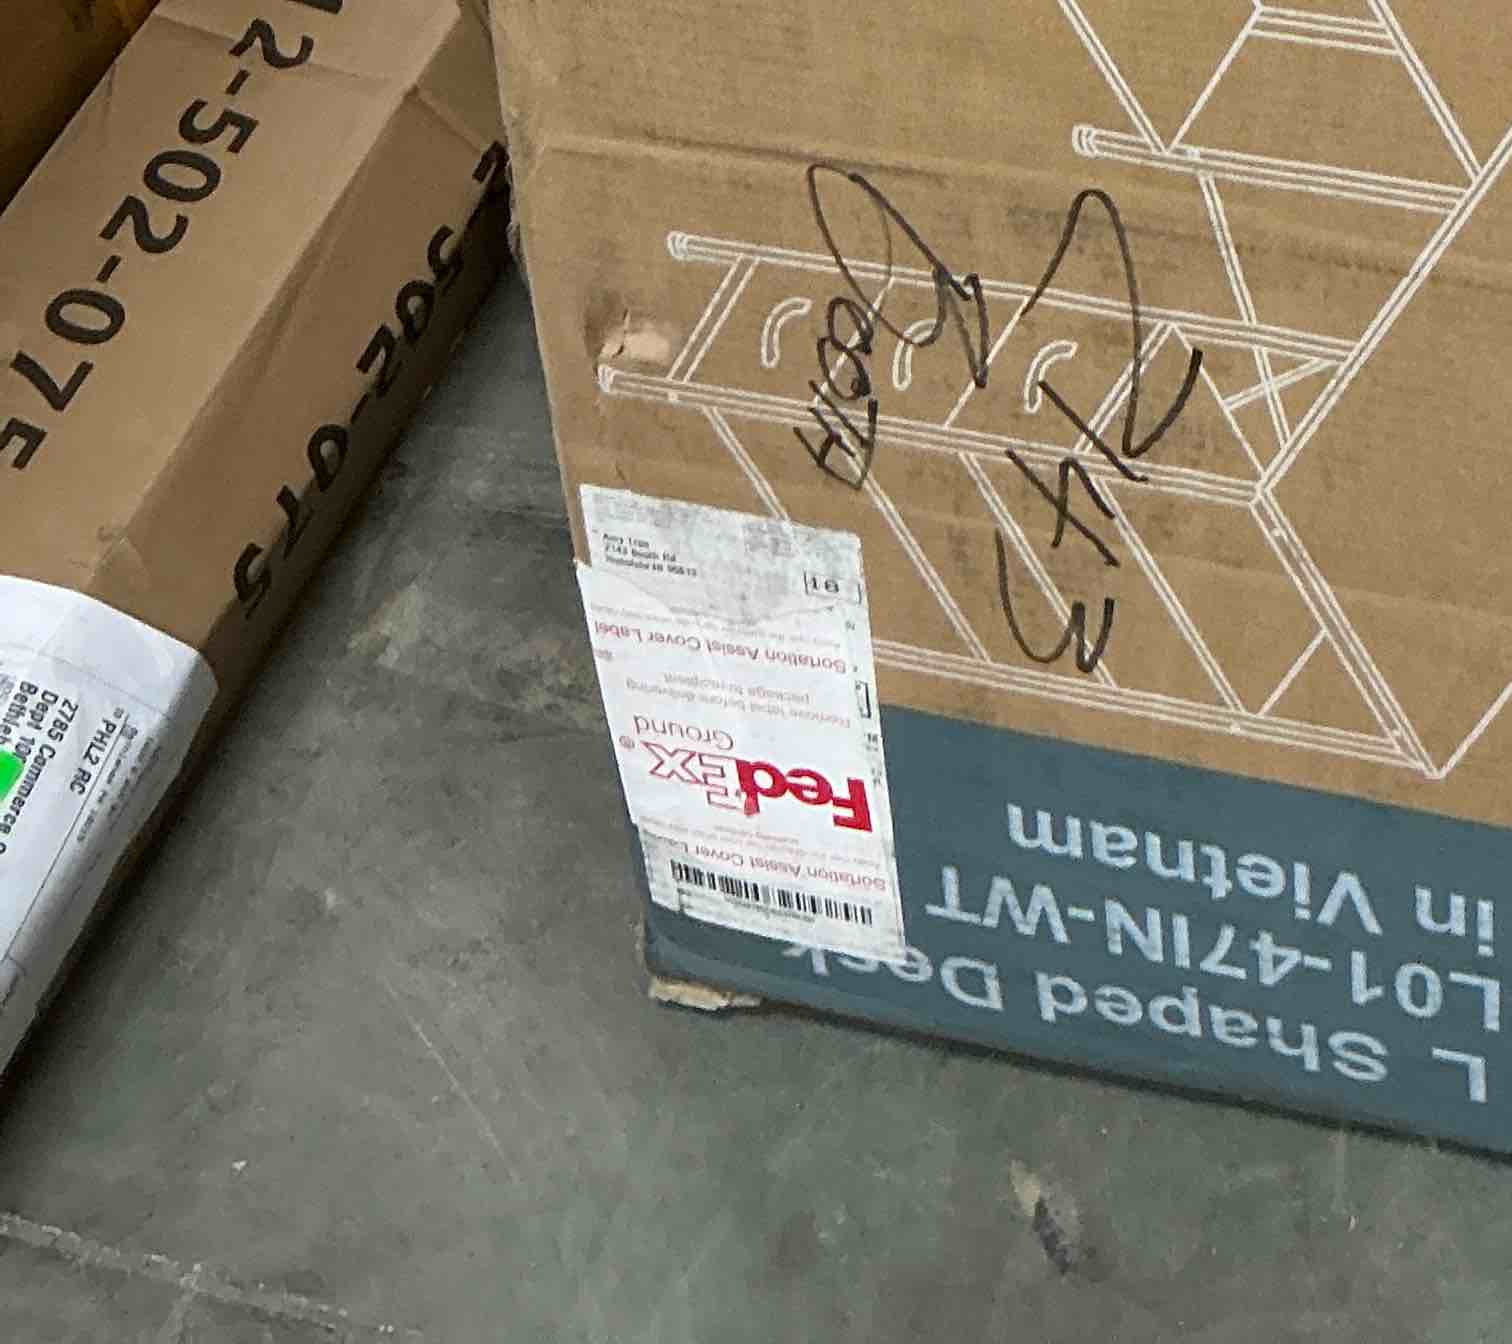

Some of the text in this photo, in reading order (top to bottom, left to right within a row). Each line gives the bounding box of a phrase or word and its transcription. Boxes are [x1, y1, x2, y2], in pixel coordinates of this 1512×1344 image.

[594, 620, 847, 674] Sortation Assist Cover Label
[27, 689, 60, 731] Dept
[632, 714, 735, 752] Ground
[69, 717, 117, 796] PHL2 RC
[640, 740, 873, 833] FedEx
[695, 843, 745, 868] Cover
[750, 856, 802, 880] Assist
[805, 864, 888, 892] Sortation
[1006, 802, 1384, 937] Vietnam
[1414, 884, 1495, 958] in
[1034, 970, 1389, 1083] Shaped
[1431, 1046, 1488, 1104] L
